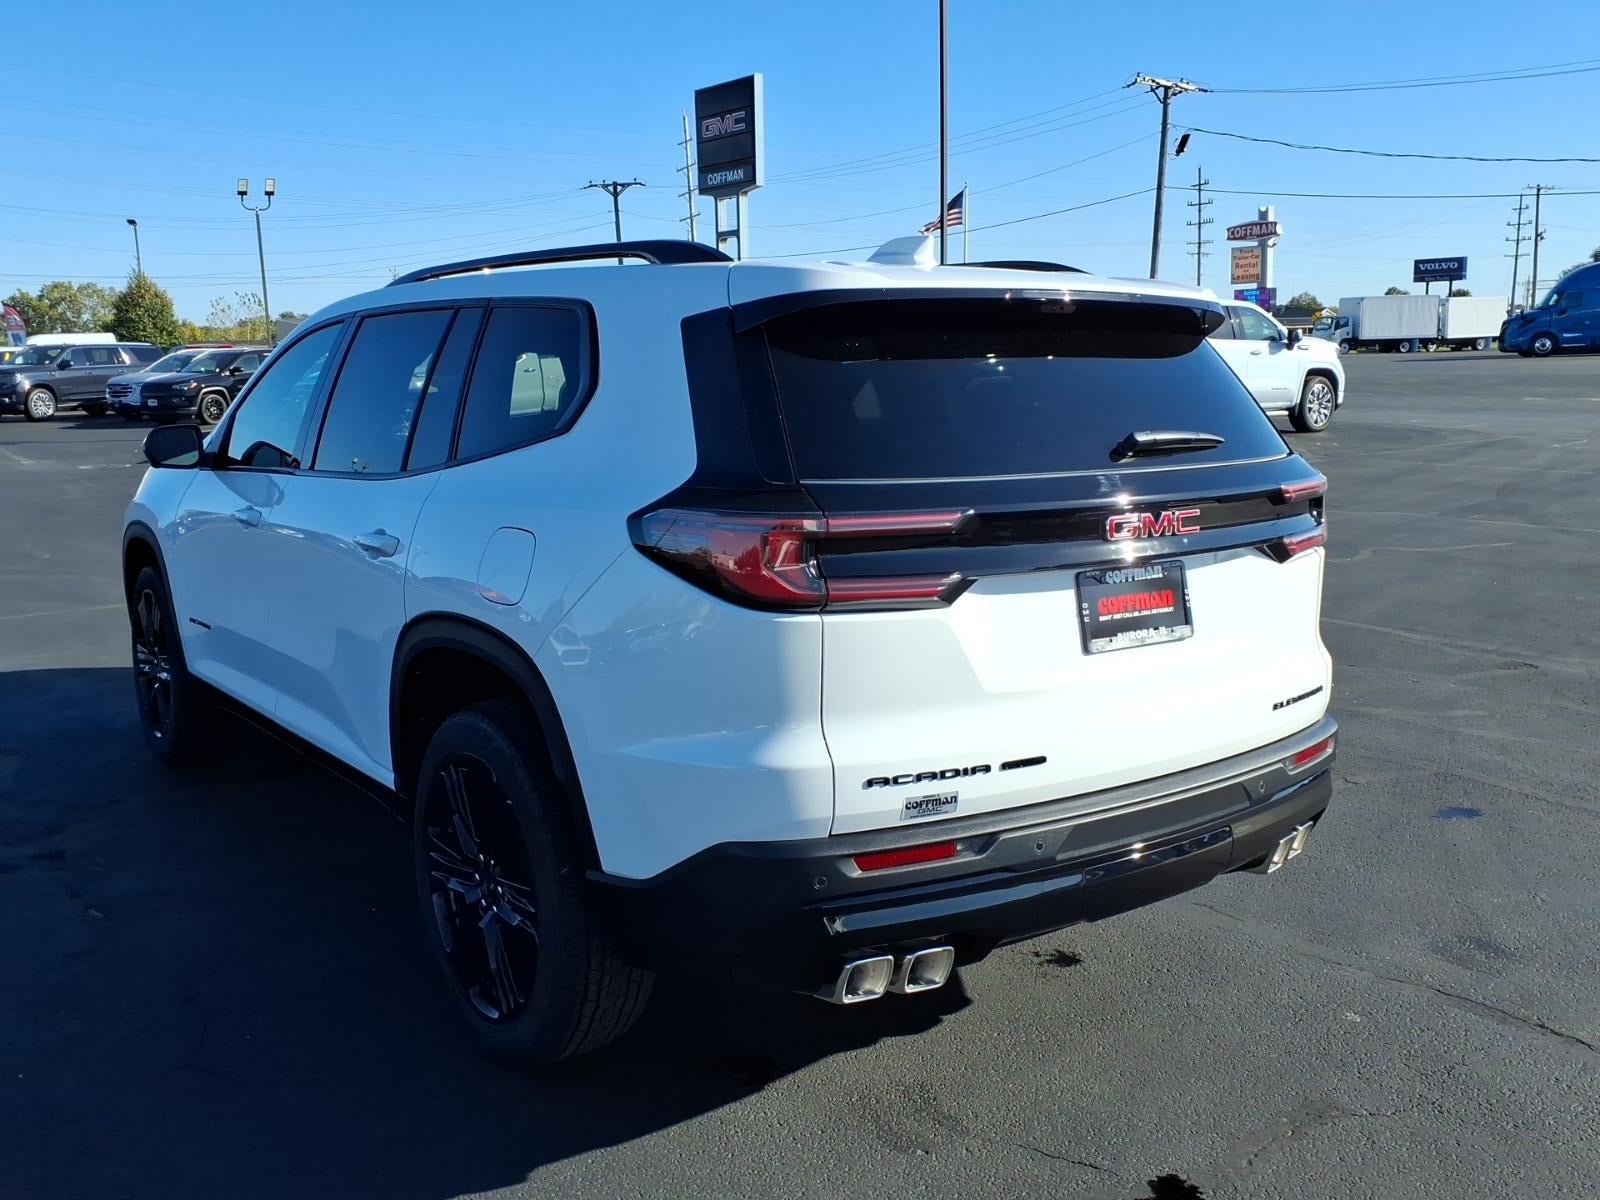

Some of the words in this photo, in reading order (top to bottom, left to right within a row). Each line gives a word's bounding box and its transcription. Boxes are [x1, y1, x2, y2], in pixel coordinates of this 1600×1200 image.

[702, 111, 745, 138] GMC
[707, 168, 744, 185] COFFMAN
[1229, 223, 1275, 238] COFFMAN
[1235, 261, 1258, 270] Rental
[1418, 261, 1458, 271] VOLVO
[1232, 273, 1260, 281] Leasing
[1107, 508, 1200, 540] GMC
[1105, 565, 1164, 584] COFFMAN
[1098, 590, 1174, 615] COFFMAN
[863, 764, 992, 790] ACADIA
[905, 795, 957, 811] COFFMAN
[917, 806, 944, 815] GMC
